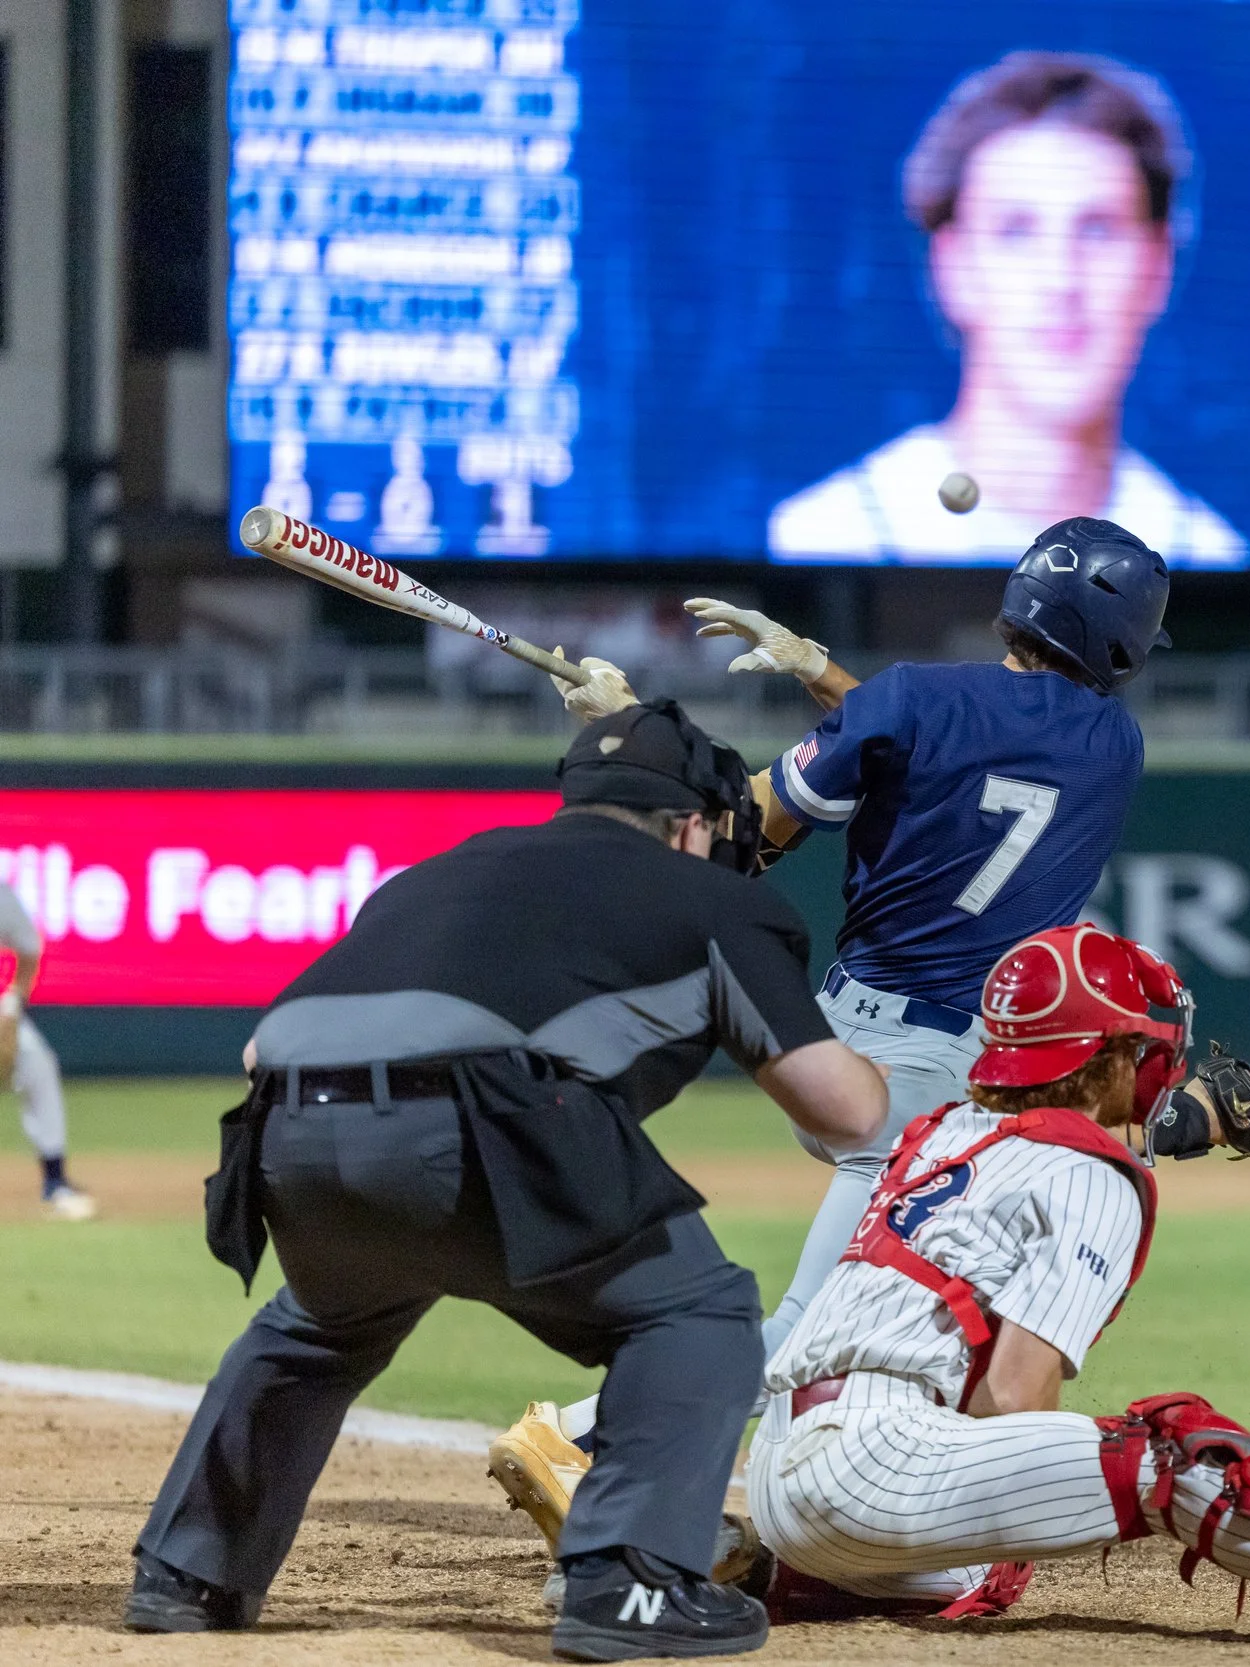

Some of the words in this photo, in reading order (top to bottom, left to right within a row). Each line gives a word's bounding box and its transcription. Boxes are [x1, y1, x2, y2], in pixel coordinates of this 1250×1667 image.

[273, 513, 401, 592] marucci
[1026, 599, 1043, 619] 7
[951, 773, 1060, 917] 7
[147, 844, 410, 942] Fearl
